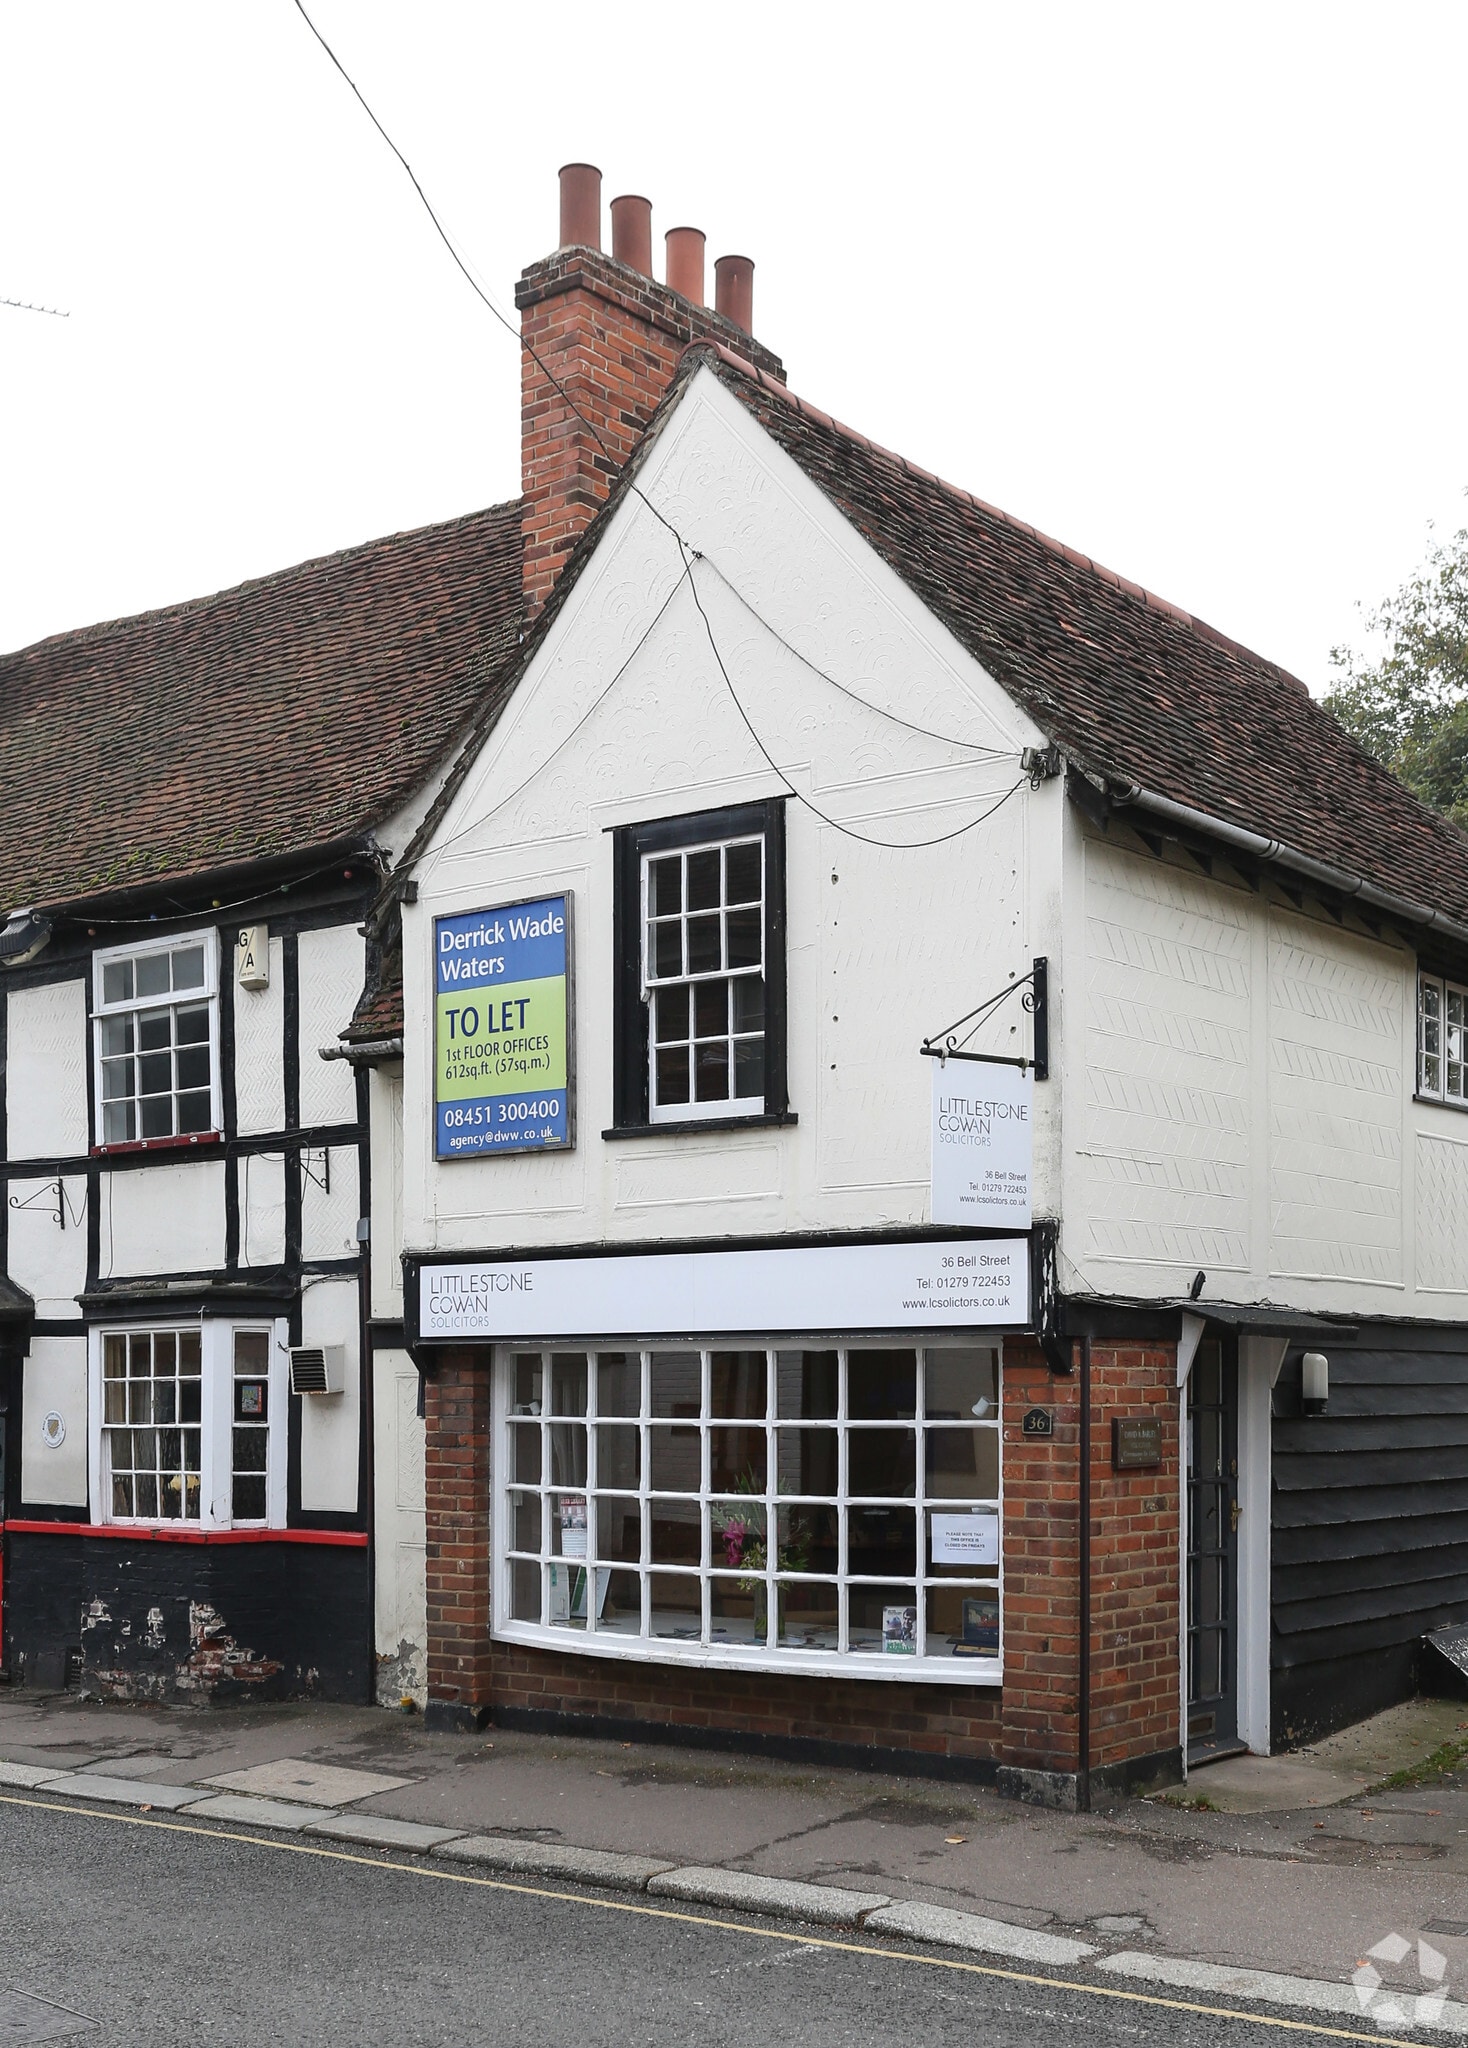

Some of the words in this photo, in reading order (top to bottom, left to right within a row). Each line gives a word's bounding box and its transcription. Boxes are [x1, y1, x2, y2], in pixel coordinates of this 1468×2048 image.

[240, 931, 248, 947] G
[440, 921, 505, 953] Derrick
[508, 911, 564, 941] Wade
[246, 952, 255, 968] A
[441, 956, 505, 982] Waters
[445, 1006, 479, 1039] TO
[488, 998, 531, 1033] LET
[446, 1048, 461, 1062] 1st
[464, 1042, 500, 1060] FLOOR
[503, 1035, 549, 1054] OFFICES
[445, 1061, 492, 1081] 612sq.ft.
[495, 1053, 551, 1076] (57sq.m.)
[444, 1106, 491, 1128] 08451
[498, 1099, 560, 1123] 300400
[940, 1097, 1028, 1121] LITTLESTONE
[938, 1115, 991, 1135] COWAN
[450, 1125, 553, 1149] agency@dww.co.uk
[939, 1133, 992, 1147] SOLICITORS
[984, 1170, 993, 1179] 36
[994, 1171, 1007, 1180] Bell
[1008, 1171, 1027, 1182] Street
[981, 1183, 1002, 1193] 01279
[1003, 1184, 1027, 1195] 722453
[941, 1257, 954, 1268] 36
[957, 1256, 976, 1267] Bell
[979, 1255, 1010, 1266] Street
[431, 1272, 533, 1294] LITTLESTONE
[916, 1278, 934, 1289] Tel:
[936, 1276, 969, 1289] 01279
[971, 1275, 1011, 1287] 722453
[429, 1295, 488, 1315] COWAN
[902, 1295, 1010, 1309] www.lcsolictors.co.uk
[430, 1315, 490, 1329] SOLICITORS
[1028, 1416, 1046, 1430] 36
